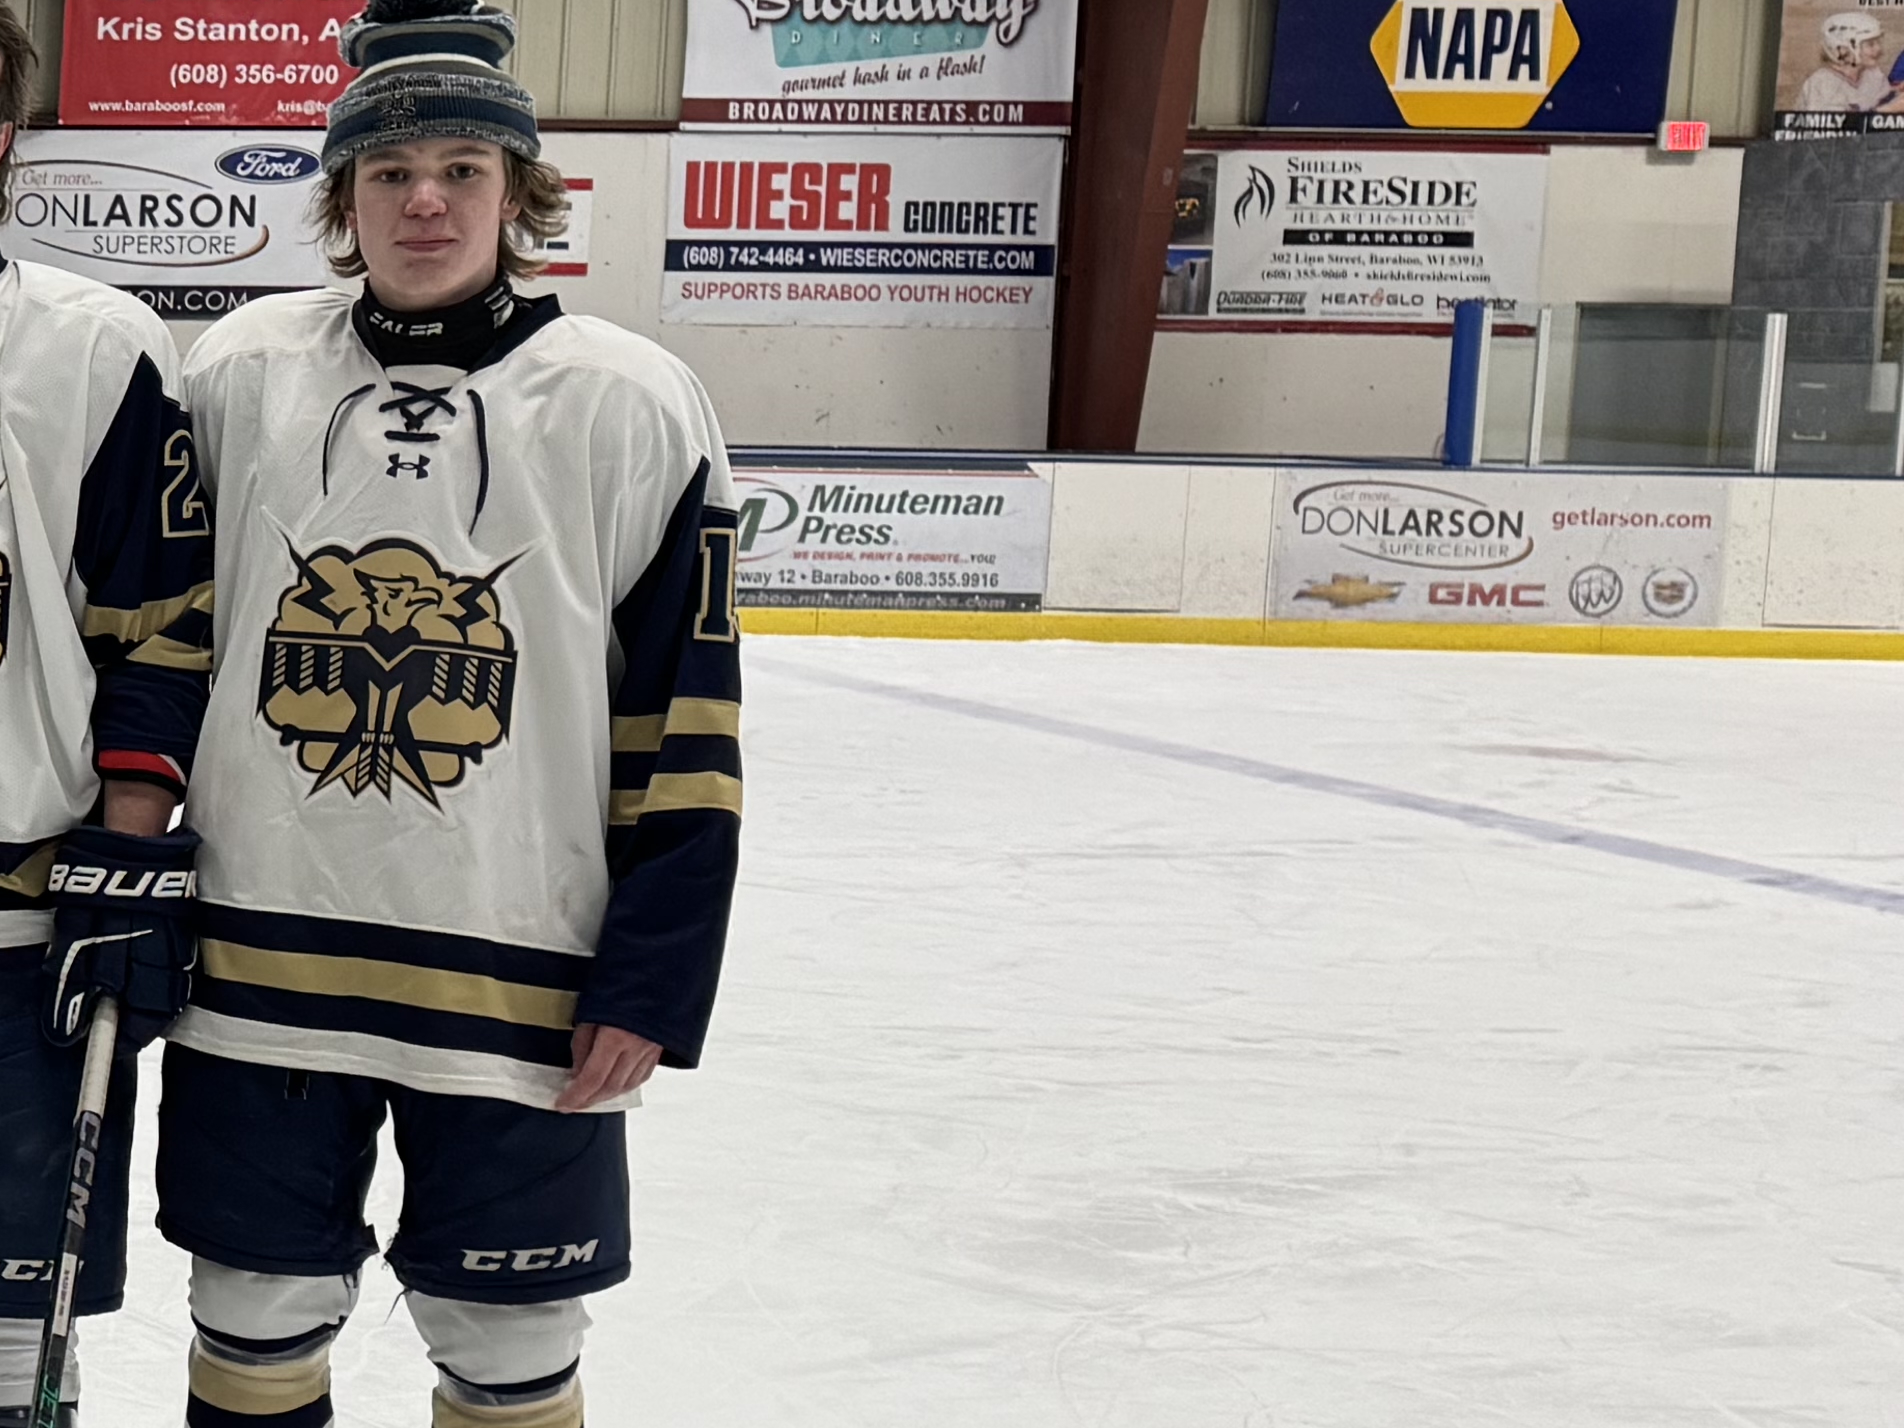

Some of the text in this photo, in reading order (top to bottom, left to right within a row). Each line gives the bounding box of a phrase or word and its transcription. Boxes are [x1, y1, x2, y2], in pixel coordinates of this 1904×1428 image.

[97, 17, 309, 45] Kris Stanton,
[791, 31, 964, 45] DINER
[1404, 8, 1542, 82] NAPA
[169, 63, 228, 89] (608)
[235, 63, 340, 86] 356-6700
[781, 74, 847, 98] gourmet
[853, 64, 889, 85] hash
[896, 62, 912, 81] in
[919, 64, 929, 78] a
[89, 98, 226, 114] www.baraboosf.com
[727, 101, 1024, 123] BROADWAYDINEREATS.COM
[1784, 113, 1846, 128] FAMILY
[236, 149, 301, 178] Ford
[21, 172, 103, 186] Get more...
[683, 160, 893, 232] WIESER
[15, 192, 257, 228] ONLARSON
[903, 200, 1038, 237] CONCRETE
[92, 234, 236, 255] SUPERSTORE
[1309, 232, 1445, 245] OF BARABOO
[683, 246, 1035, 270] (608) 742-4464 WIESERCONCRETE.COM
[1270, 252, 1291, 264] 302
[1427, 254, 1446, 265] WI
[681, 282, 1034, 304] SUPPORTS BARABOO YOUTH HOCKEY
[807, 484, 1006, 516] Minuteman
[797, 514, 894, 547] Press
[1551, 508, 1713, 531] getlarson.com
[1378, 541, 1509, 559] SUPERCENTER
[779, 571, 999, 588] 12 Baraboo 608.355.9916
[737, 592, 1006, 609] raboo.minutemanpress.com
[1428, 581, 1546, 607] GMC
[48, 863, 196, 898] BAUE
[64, 1109, 102, 1229] CCM
[459, 1238, 599, 1273] CCM
